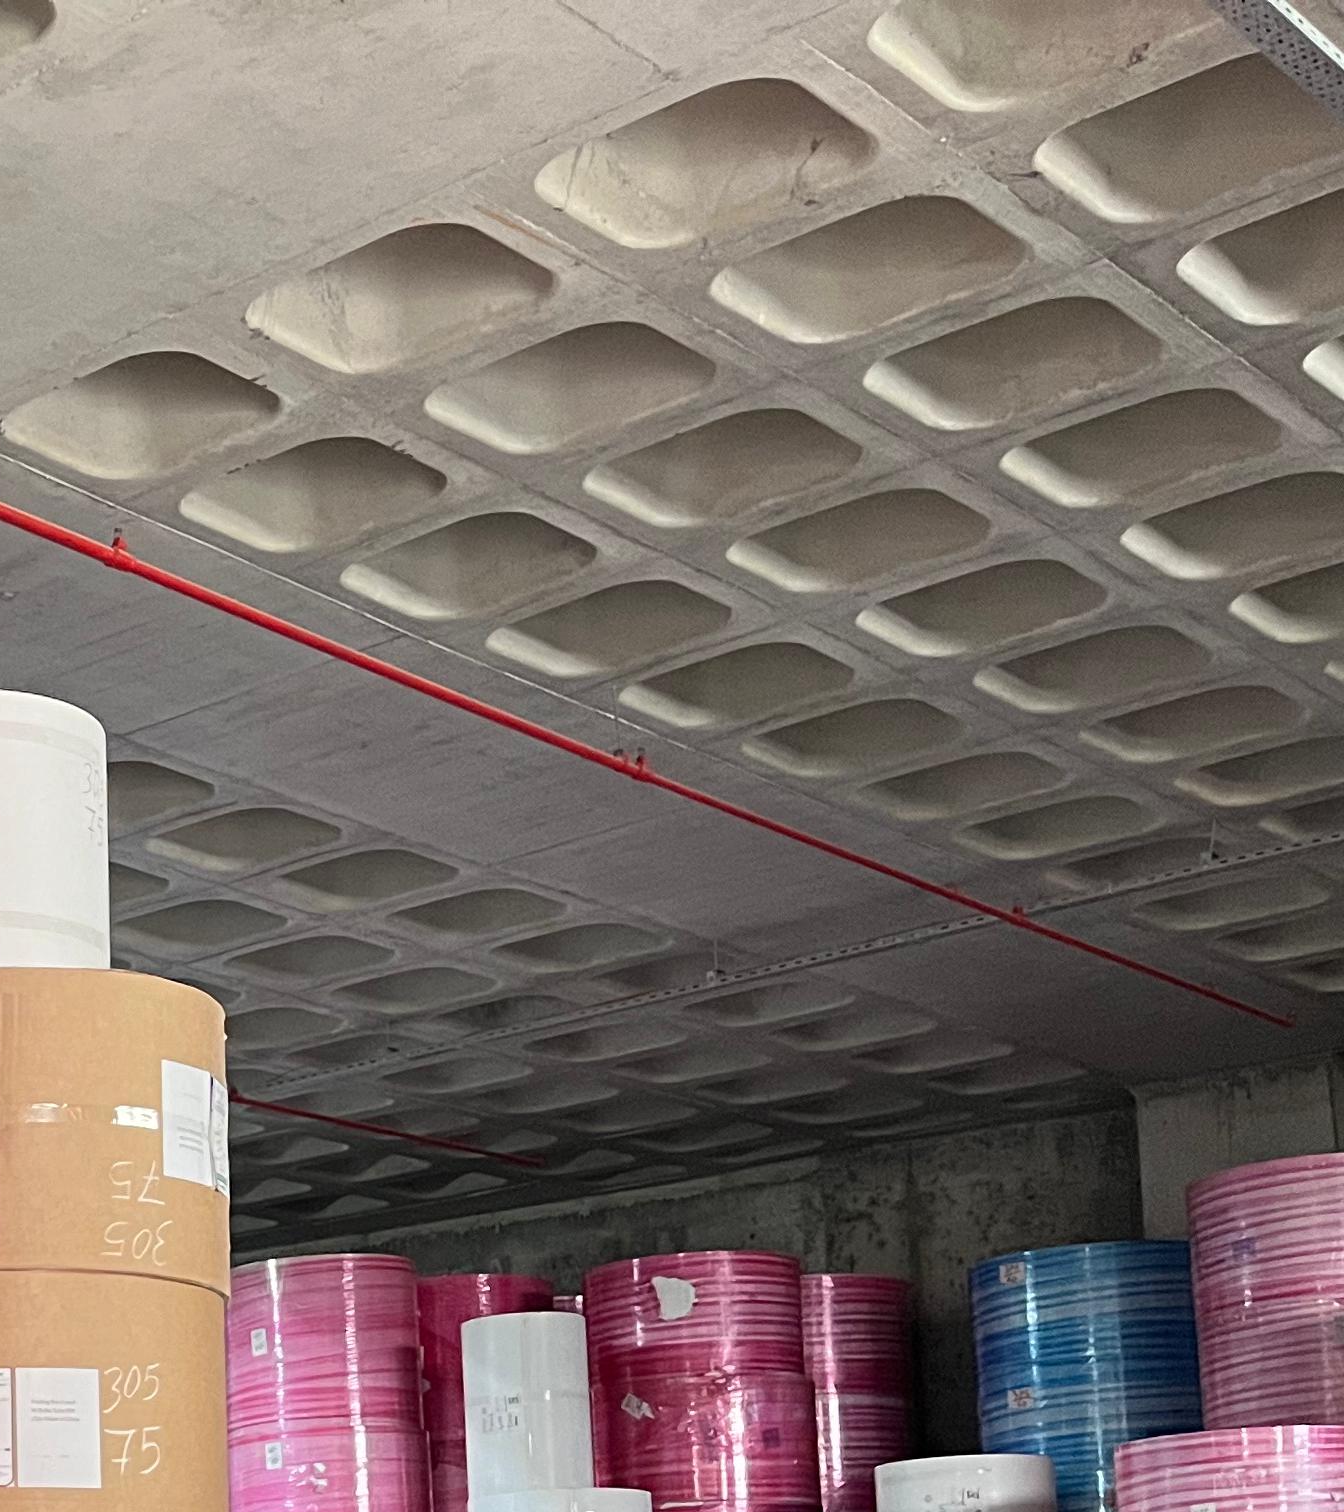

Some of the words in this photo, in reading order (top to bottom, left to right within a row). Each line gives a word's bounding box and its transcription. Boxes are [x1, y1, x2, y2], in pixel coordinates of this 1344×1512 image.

[108, 1160, 166, 1206] 75
[100, 1220, 173, 1266] 305
[103, 1363, 160, 1414] 305
[104, 1426, 161, 1476] 75
